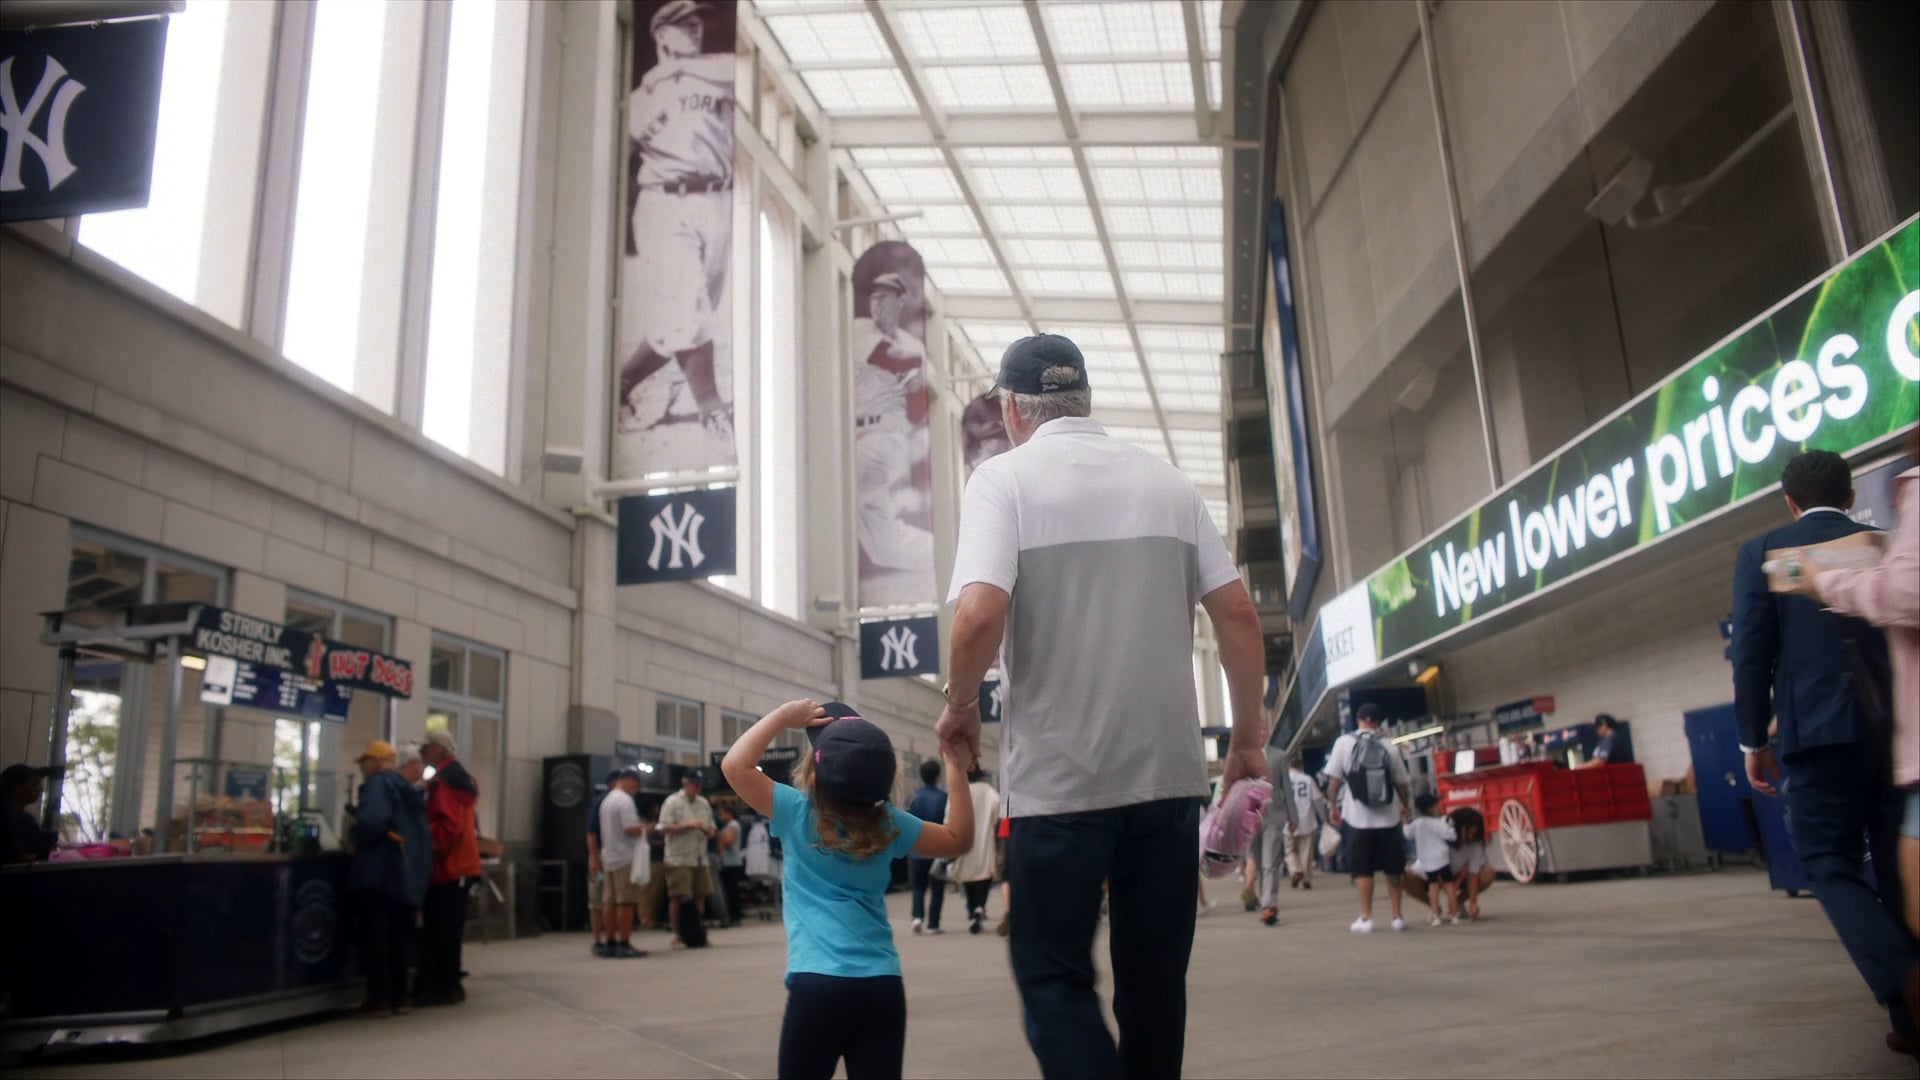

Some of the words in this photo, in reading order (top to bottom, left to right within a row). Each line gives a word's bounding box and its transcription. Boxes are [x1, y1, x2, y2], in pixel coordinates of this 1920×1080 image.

[1431, 533, 1508, 617] New
[1508, 455, 1635, 579] lower
[1644, 331, 1869, 533] prices
[647, 501, 707, 571] NY
[196, 628, 264, 663] KOSHER
[264, 644, 294, 669] INC.
[220, 611, 284, 645] STRIKLY
[879, 624, 919, 673] NY
[329, 649, 371, 681] HOT
[372, 654, 415, 696] DOGS
